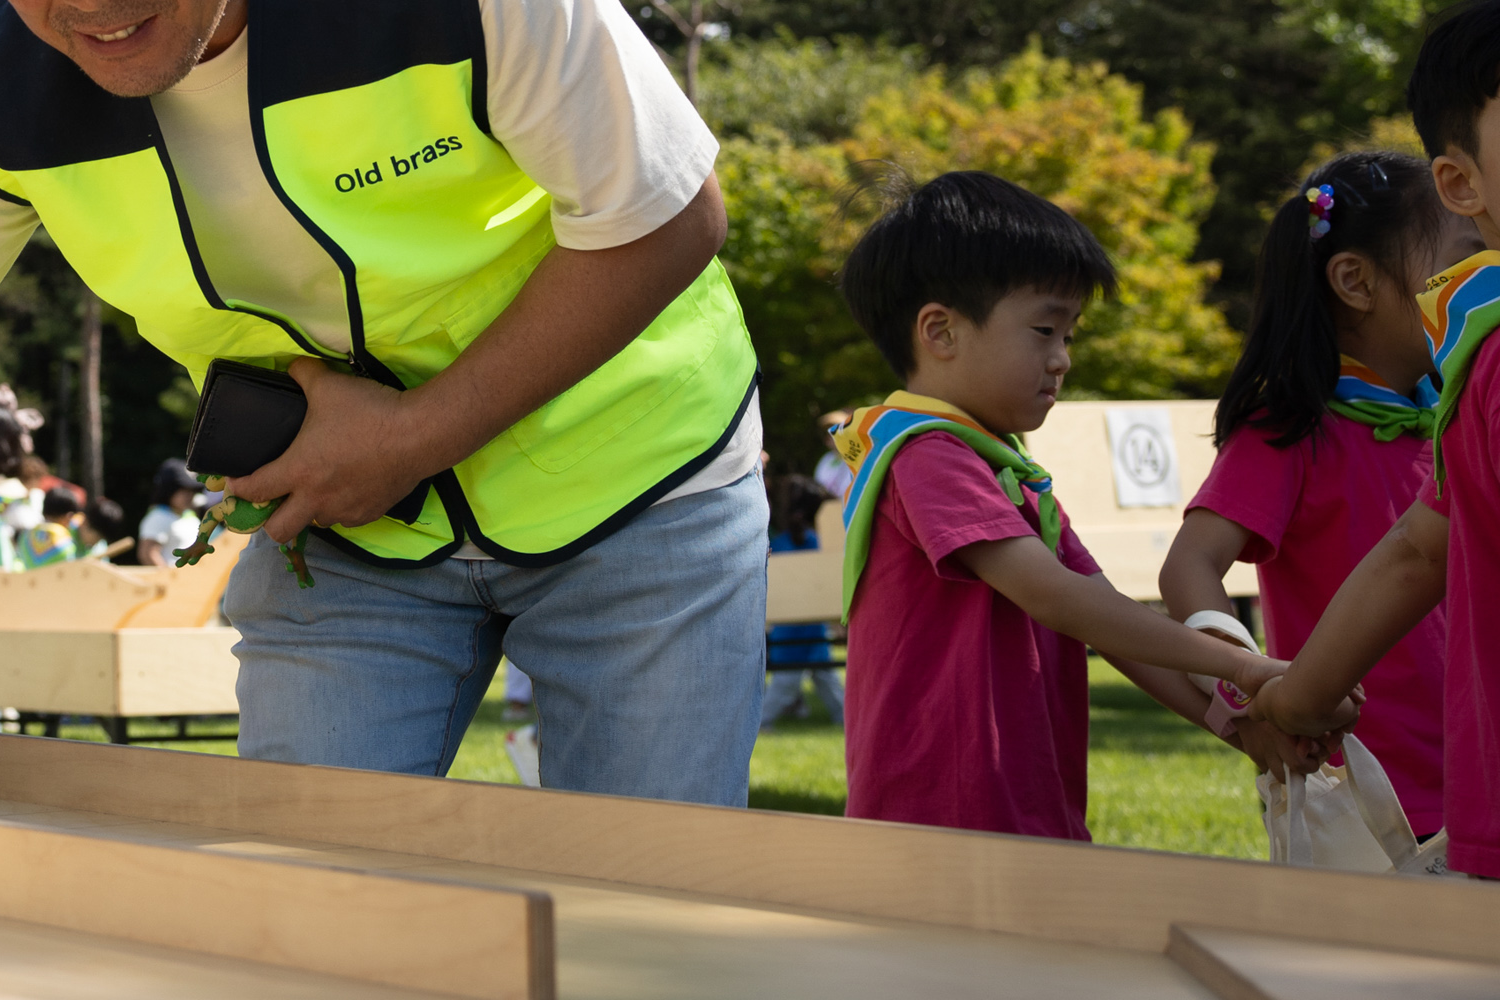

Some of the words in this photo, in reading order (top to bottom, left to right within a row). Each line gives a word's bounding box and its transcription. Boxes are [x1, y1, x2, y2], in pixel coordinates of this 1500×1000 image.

[334, 161, 383, 193] Old
[390, 135, 463, 177] brass
[1130, 438, 1159, 475] 14
